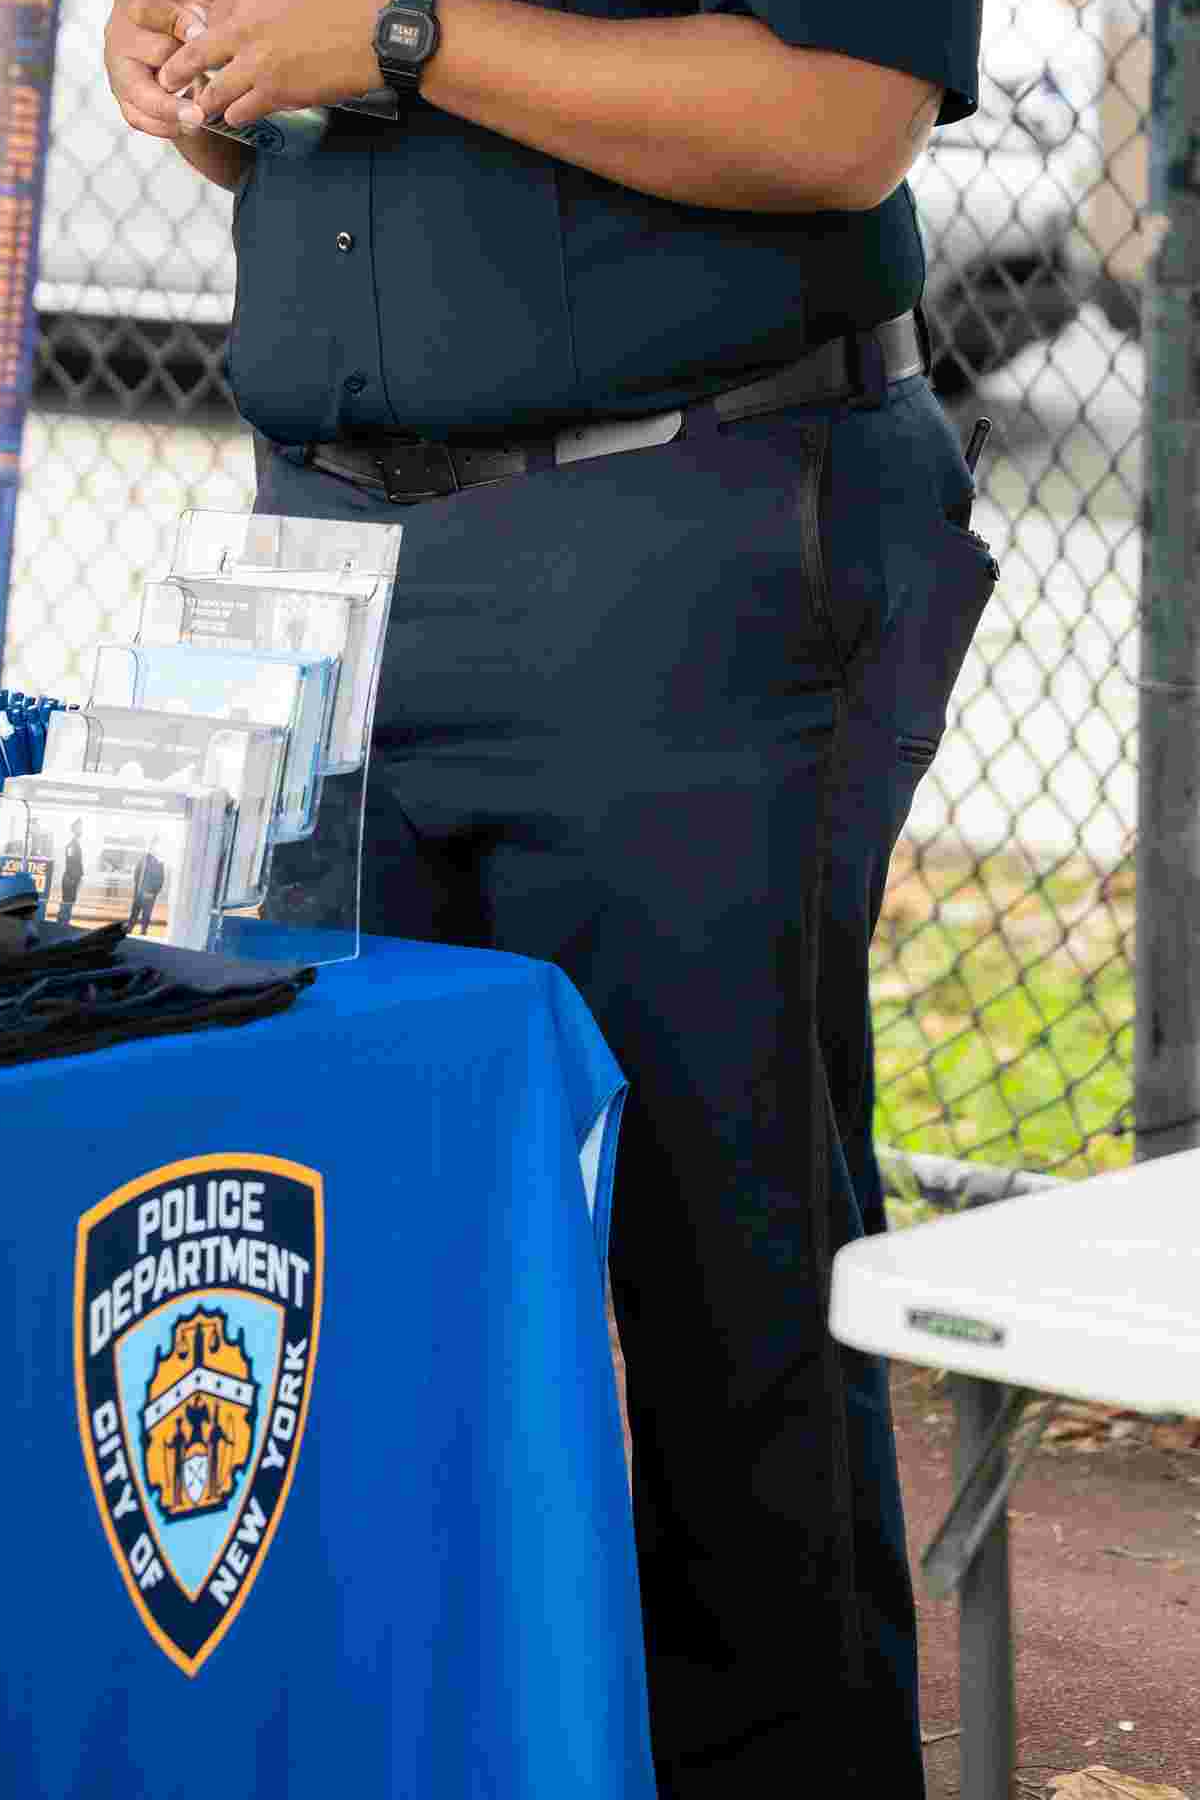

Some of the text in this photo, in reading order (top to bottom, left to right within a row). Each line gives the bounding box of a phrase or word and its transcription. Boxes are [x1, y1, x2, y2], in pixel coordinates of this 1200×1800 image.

[137, 1178, 266, 1256] POLICE
[88, 1235, 310, 1357] DEPARTMENT
[93, 1398, 165, 1590] CITY OF
[207, 1335, 308, 1607] NEW YORK
